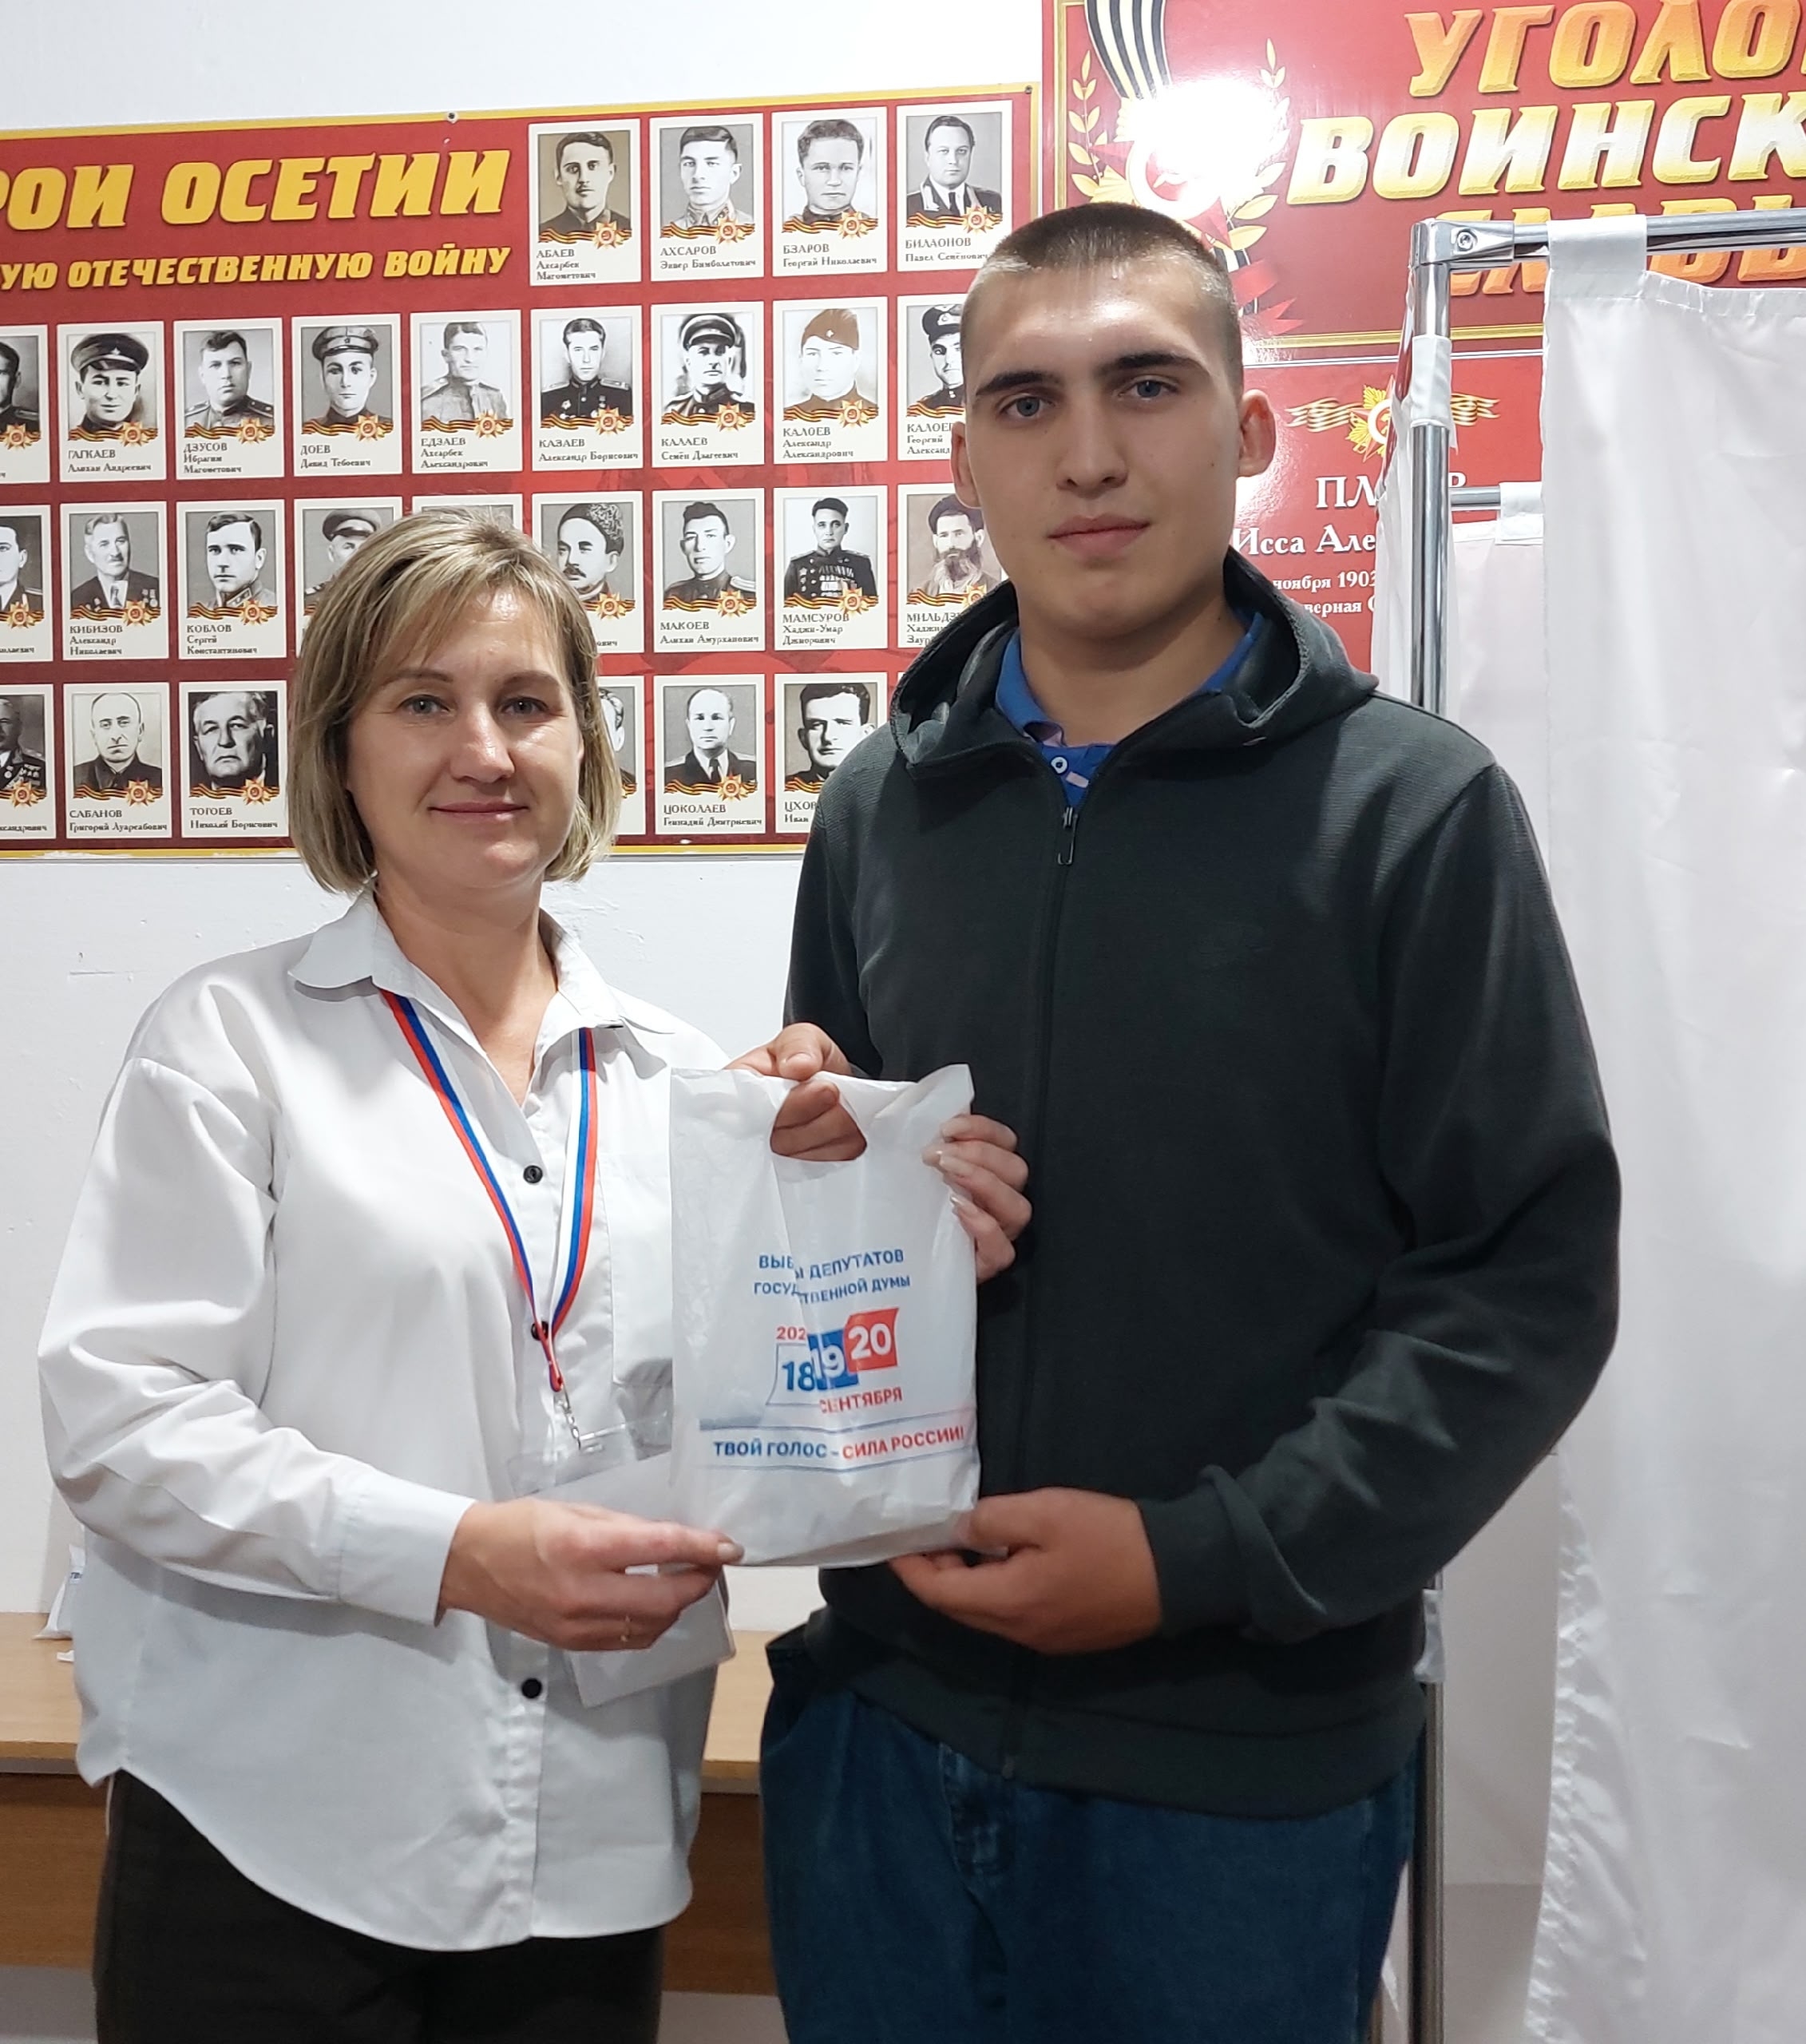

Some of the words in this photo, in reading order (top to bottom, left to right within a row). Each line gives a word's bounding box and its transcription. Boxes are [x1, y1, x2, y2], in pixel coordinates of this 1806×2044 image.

[1404, 0, 1806, 97] УГОЛО
[1286, 91, 1806, 204] ВОИНСК
[161, 149, 511, 224] ОСЕТИИ
[905, 237, 972, 248] БИЛАОНОВ
[536, 248, 575, 258] АБАЕВ
[659, 245, 717, 256] АХСАРОВ
[783, 243, 830, 254] БЗАРОВ
[783, 257, 818, 268] Георгий
[822, 256, 877, 266] Николаевич
[905, 253, 934, 262] Павел
[68, 252, 374, 288] ОТЕЧЕСТВЕННУЮ
[383, 243, 511, 277] ВОЙНУ
[782, 426, 831, 437] КАЛОЕВ
[420, 438, 466, 447] ЕДЗАЕВ
[539, 438, 585, 448] КАЗАЕВ
[661, 438, 708, 446] КАЛАЕВ
[782, 439, 832, 449] Александр
[907, 434, 943, 445] Георгий
[184, 442, 228, 453] ДЗУСОВ
[300, 445, 331, 455] ДОЕВ
[68, 450, 116, 459] ГАГКАЕВ
[184, 454, 223, 464] Ибрагим
[539, 452, 587, 462] Александр
[590, 451, 639, 461] Борисович
[661, 450, 690, 460] Семён
[782, 450, 854, 459] Александрович
[103, 463, 152, 473] Андреевич
[300, 458, 328, 469] Давид
[420, 460, 489, 469] Александрович
[184, 465, 242, 473] Магометович
[1232, 527, 1305, 555] Исса
[1316, 524, 1376, 553] Але
[1303, 602, 1362, 617] верная
[782, 613, 850, 623] МАМСУРОВ
[906, 612, 960, 623] МИЛЬДЗ
[69, 625, 123, 634] КИБИЗОВ
[187, 624, 232, 633] КОБЛОВ
[659, 621, 710, 630] МАКОЕВ
[782, 624, 843, 635] Хаджи-Умар
[906, 624, 944, 632] Хаджи
[69, 636, 117, 646] Александр
[187, 636, 217, 645] Сергей
[659, 635, 694, 644] Алихан
[906, 635, 931, 646] Заур
[69, 647, 122, 656] Николаевич
[187, 645, 257, 655] Константинович
[69, 810, 122, 818] САБАНОВ
[663, 804, 727, 814] ЦОКОЛАЕВ
[663, 817, 704, 826] Геннадий
[707, 817, 762, 828] Дмитриевич
[785, 814, 809, 822] Иван
[69, 822, 109, 833] Григорий
[232, 819, 278, 830] Борисович
[810, 1249, 904, 1280] ДЕПУТАТОВ
[872, 1275, 911, 1293] ДУМЫ
[782, 1361, 815, 1392] 18
[810, 1344, 846, 1380] 19
[848, 1322, 892, 1360] 20
[714, 1438, 762, 1457] ТВОЙ
[767, 1441, 827, 1458] ГОЛОС
[842, 1442, 888, 1460] СИЛА
[891, 1425, 964, 1452] РОССИИ!
